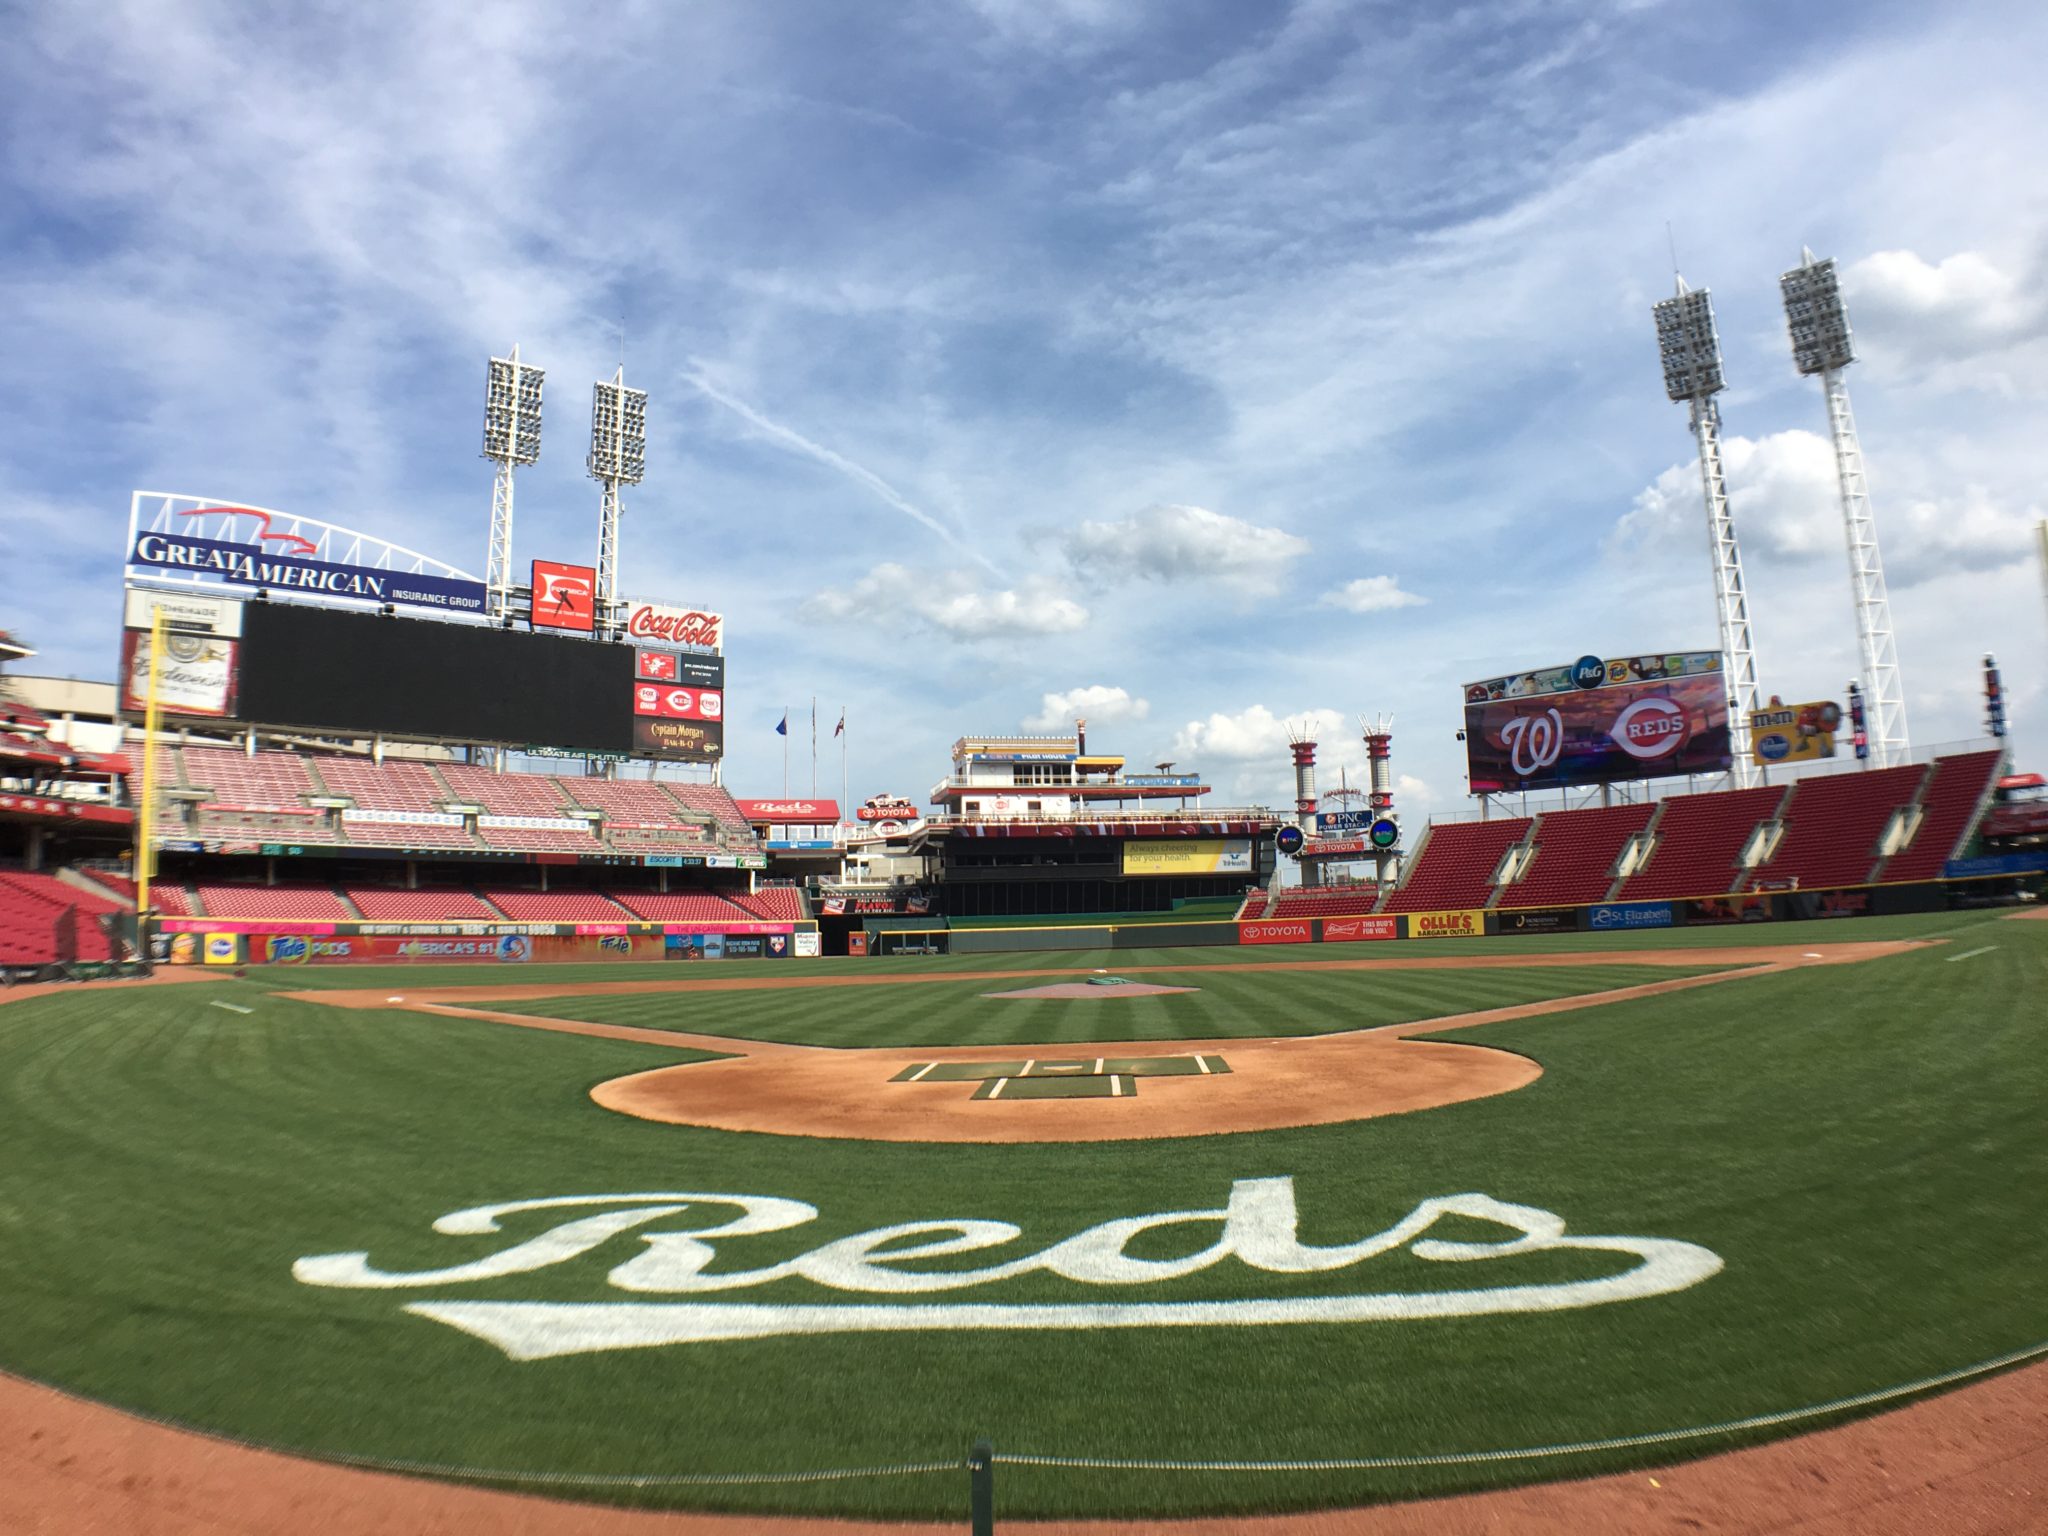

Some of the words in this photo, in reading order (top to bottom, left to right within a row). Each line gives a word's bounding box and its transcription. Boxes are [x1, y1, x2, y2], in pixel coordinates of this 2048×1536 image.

[392, 589, 447, 605] INSURANCE
[449, 596, 481, 608] GROUP
[629, 606, 721, 646] Coca-Cola
[1579, 666, 1601, 679] P&G
[1609, 667, 1627, 680] Tide
[651, 723, 677, 737] Captain
[677, 725, 704, 739] Morgan
[1629, 716, 1684, 738] REDS
[527, 749, 570, 758] ULTIMATE
[587, 753, 627, 762] SHUTTLE
[752, 802, 816, 812] Reds
[876, 808, 911, 816] TOYOTA
[1337, 812, 1362, 823] PNC
[1130, 844, 1159, 852] Always
[1161, 843, 1197, 852] cheering
[1130, 853, 1141, 861] for
[1144, 855, 1161, 863] your
[1625, 908, 1672, 920] Elizabeth
[1262, 926, 1306, 936] TOYOTA
[271, 936, 306, 959] Tide
[312, 942, 351, 956] PODS
[397, 941, 475, 954] AERICA'S
[478, 941, 496, 953] #1
[601, 938, 629, 953] Tide
[292, 1174, 1726, 1362] Reds
